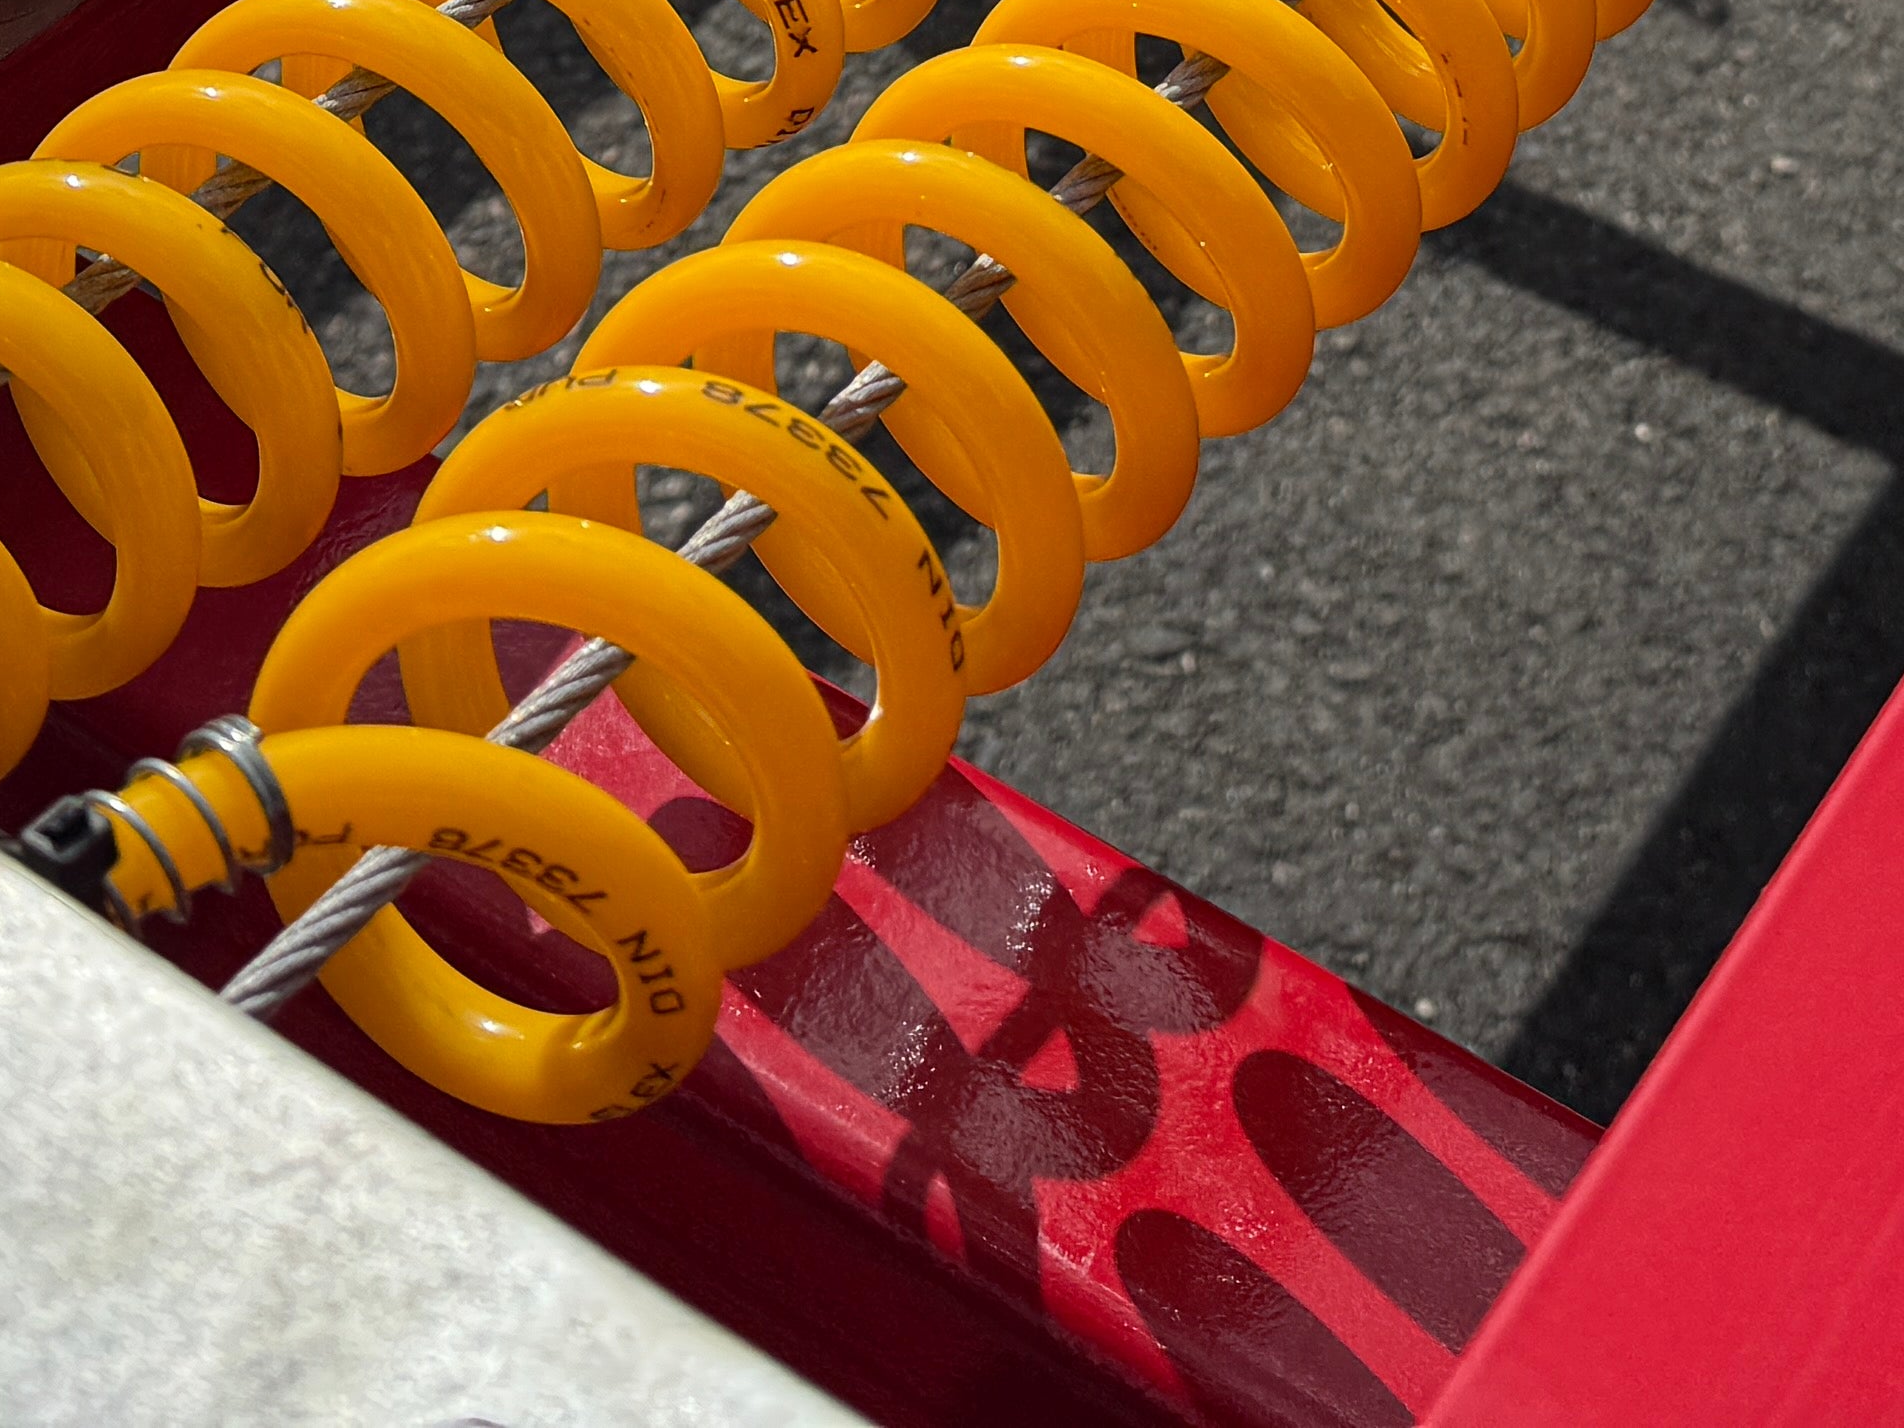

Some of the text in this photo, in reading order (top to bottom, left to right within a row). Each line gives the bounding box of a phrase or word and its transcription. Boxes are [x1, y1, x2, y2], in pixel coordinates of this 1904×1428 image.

[698, 378, 893, 521] 73378
[914, 546, 967, 674] DIN
[427, 826, 610, 917] 73378
[615, 928, 686, 1018] DIN
